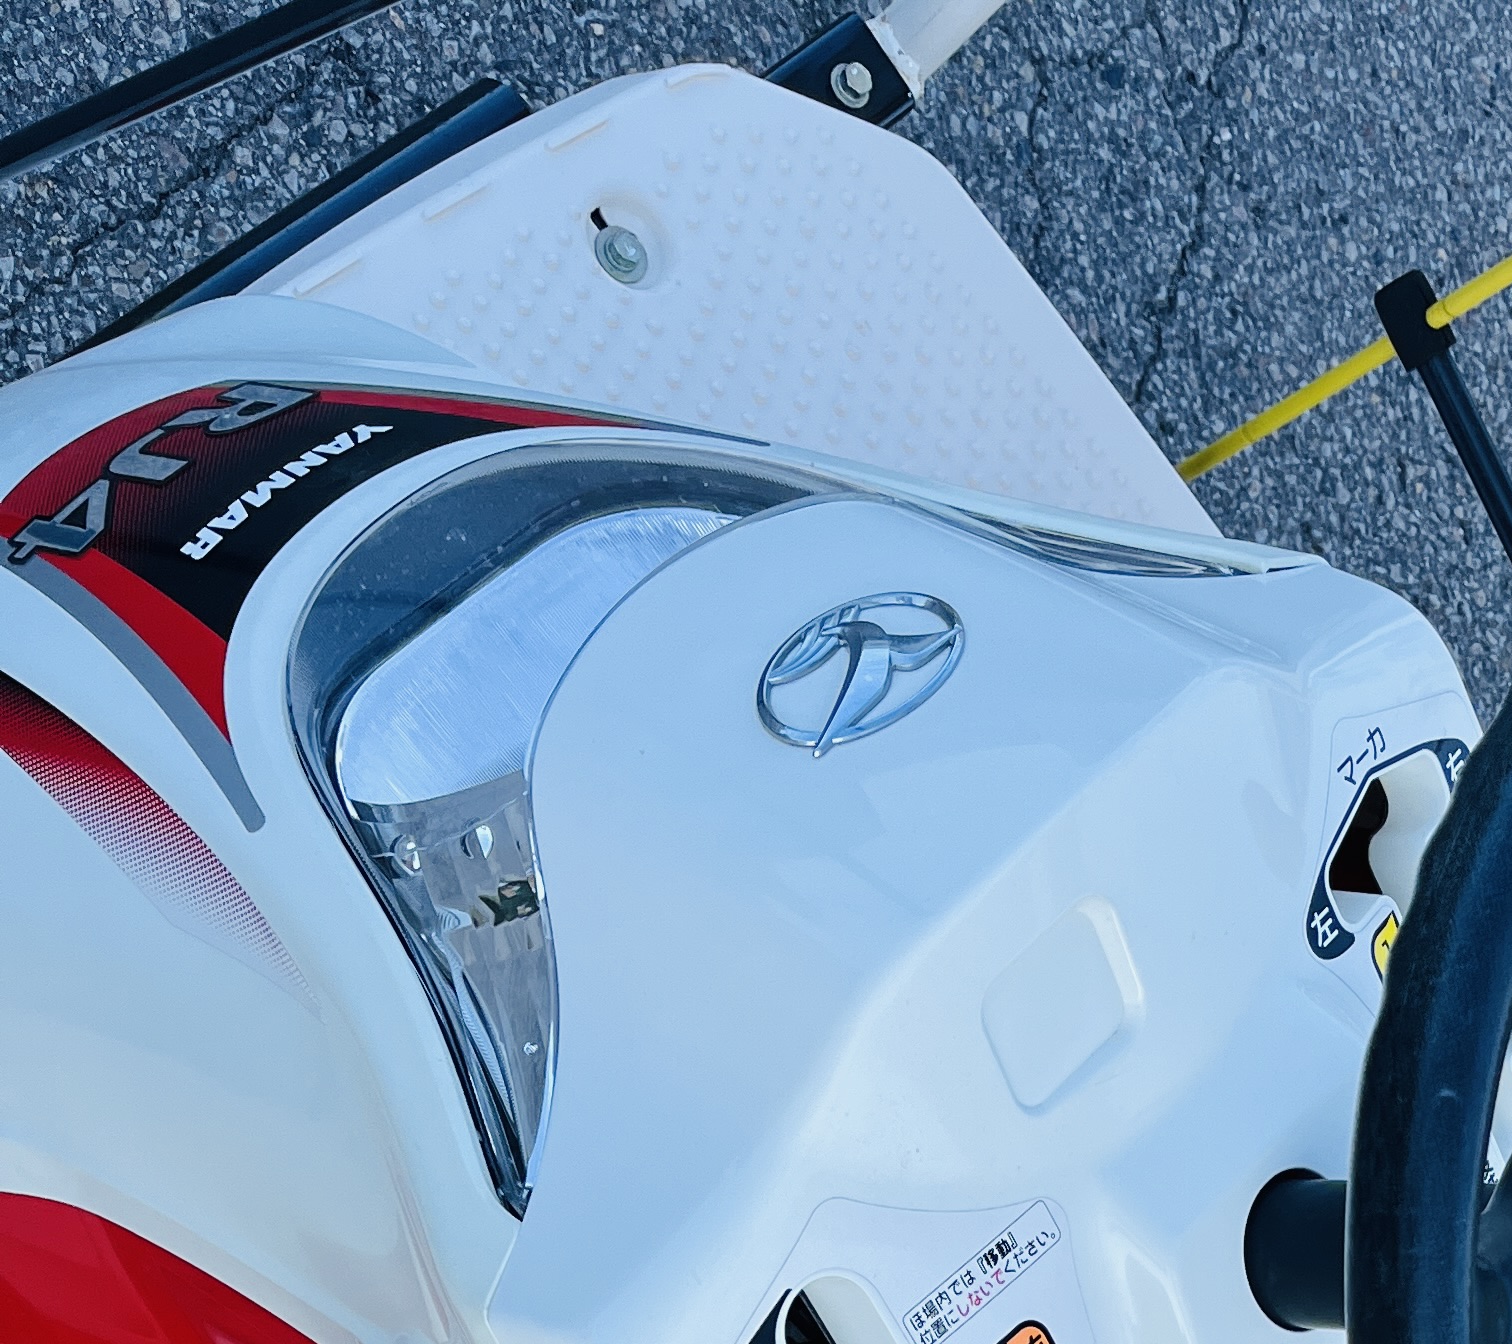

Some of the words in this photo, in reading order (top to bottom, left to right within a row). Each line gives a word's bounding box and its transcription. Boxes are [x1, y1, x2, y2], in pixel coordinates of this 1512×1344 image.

[179, 422, 394, 561] YANMAR
[1337, 726, 1386, 787] マーカ
[1310, 905, 1339, 949] 左
